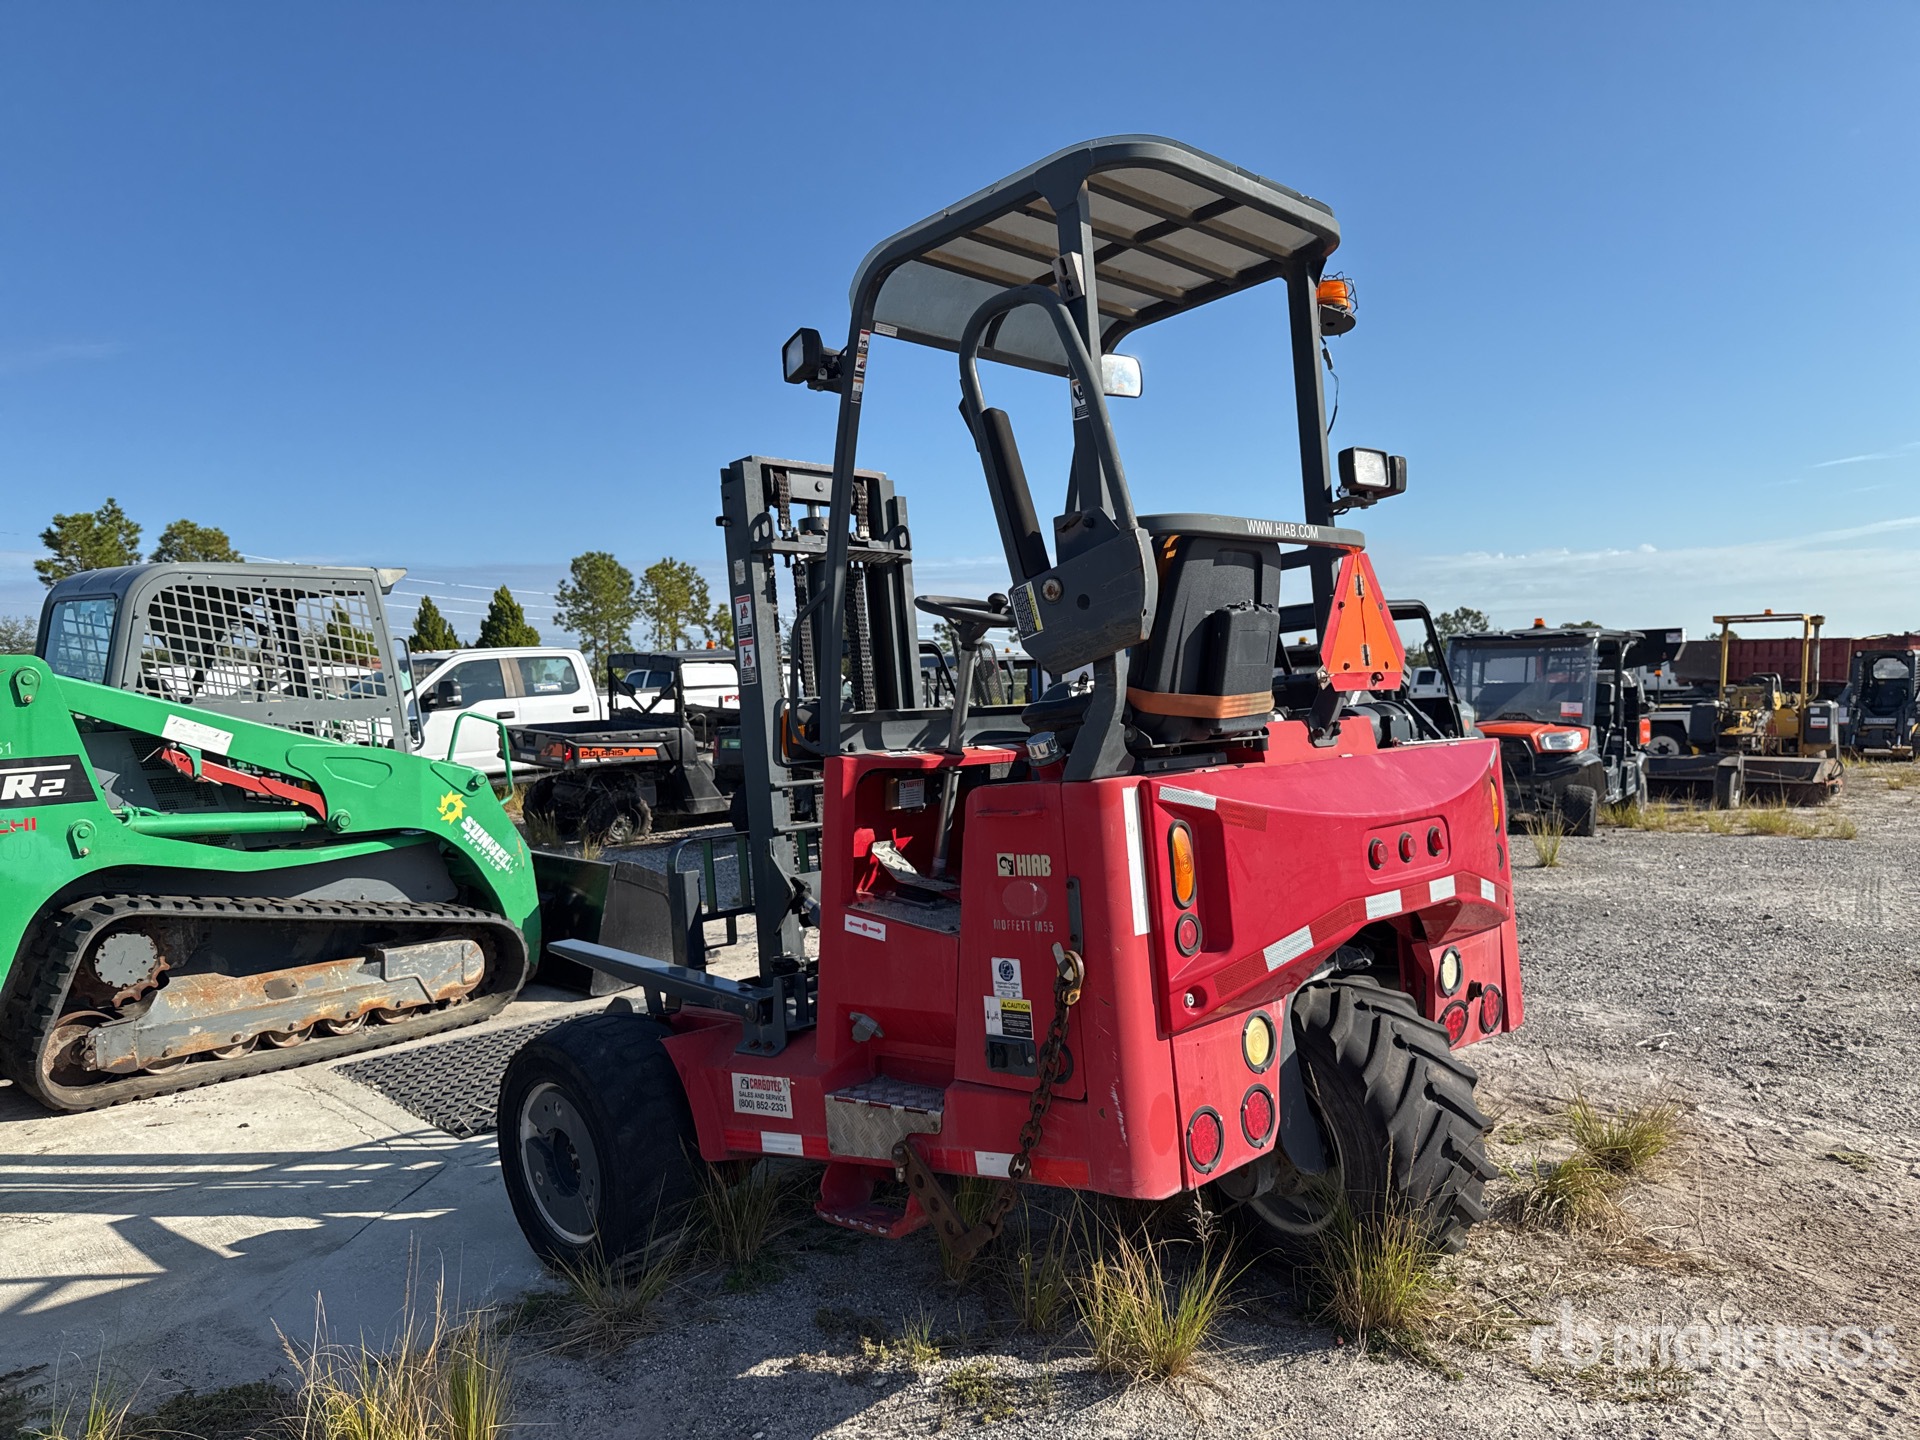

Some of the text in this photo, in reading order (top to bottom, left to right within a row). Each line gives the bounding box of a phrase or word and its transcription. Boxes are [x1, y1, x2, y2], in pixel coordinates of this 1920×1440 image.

[1246, 519, 1319, 539] WWW.HIAB.COM
[581, 750, 624, 758] POLARIS
[1016, 854, 1052, 877] HIAB
[993, 919, 1031, 932] MOFFETT
[1007, 1002, 1030, 1010] CAUTION
[750, 1078, 782, 1092] CARGOTEC
[765, 1094, 786, 1102] SERVICE
[739, 1099, 787, 1113] (800) 852-2331
